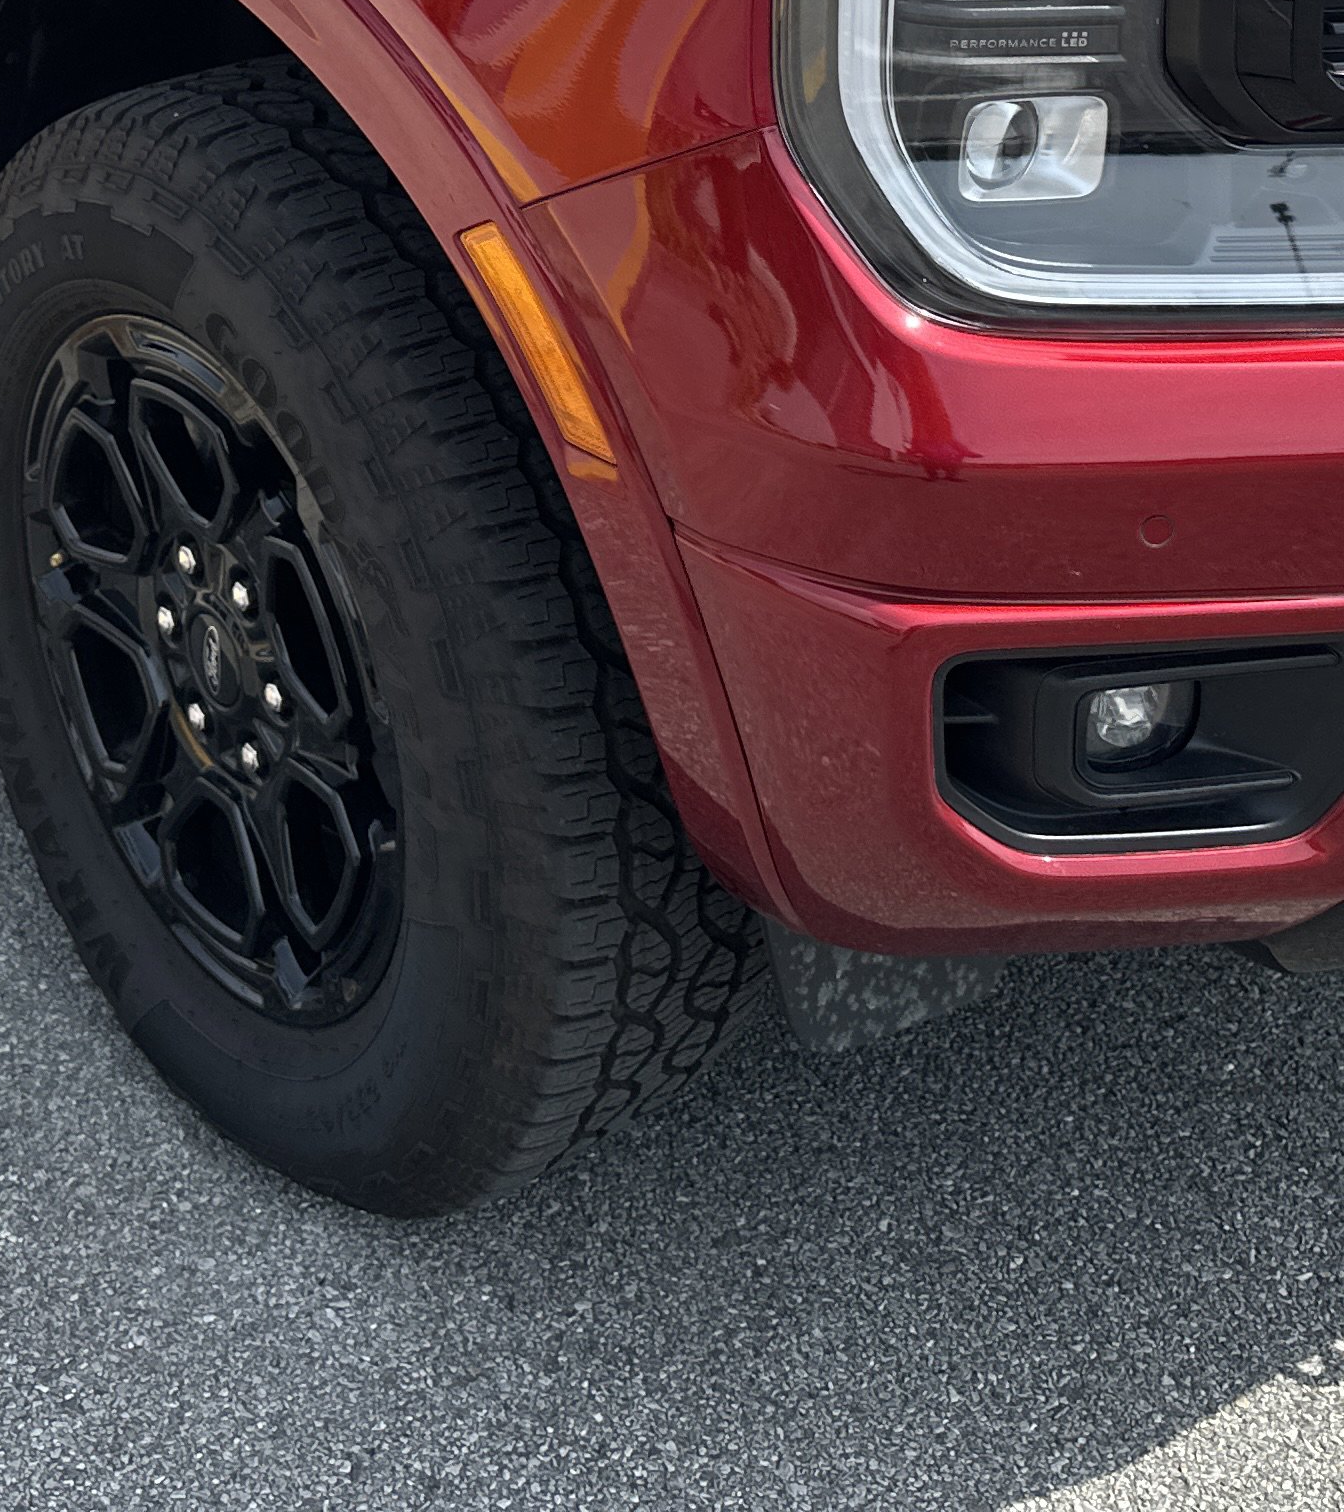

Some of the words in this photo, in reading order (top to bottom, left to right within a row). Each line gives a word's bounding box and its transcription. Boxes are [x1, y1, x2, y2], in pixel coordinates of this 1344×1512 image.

[950, 38, 1057, 49] PERFORMANCE
[1062, 37, 1088, 47] LED
[61, 234, 84, 260] AT
